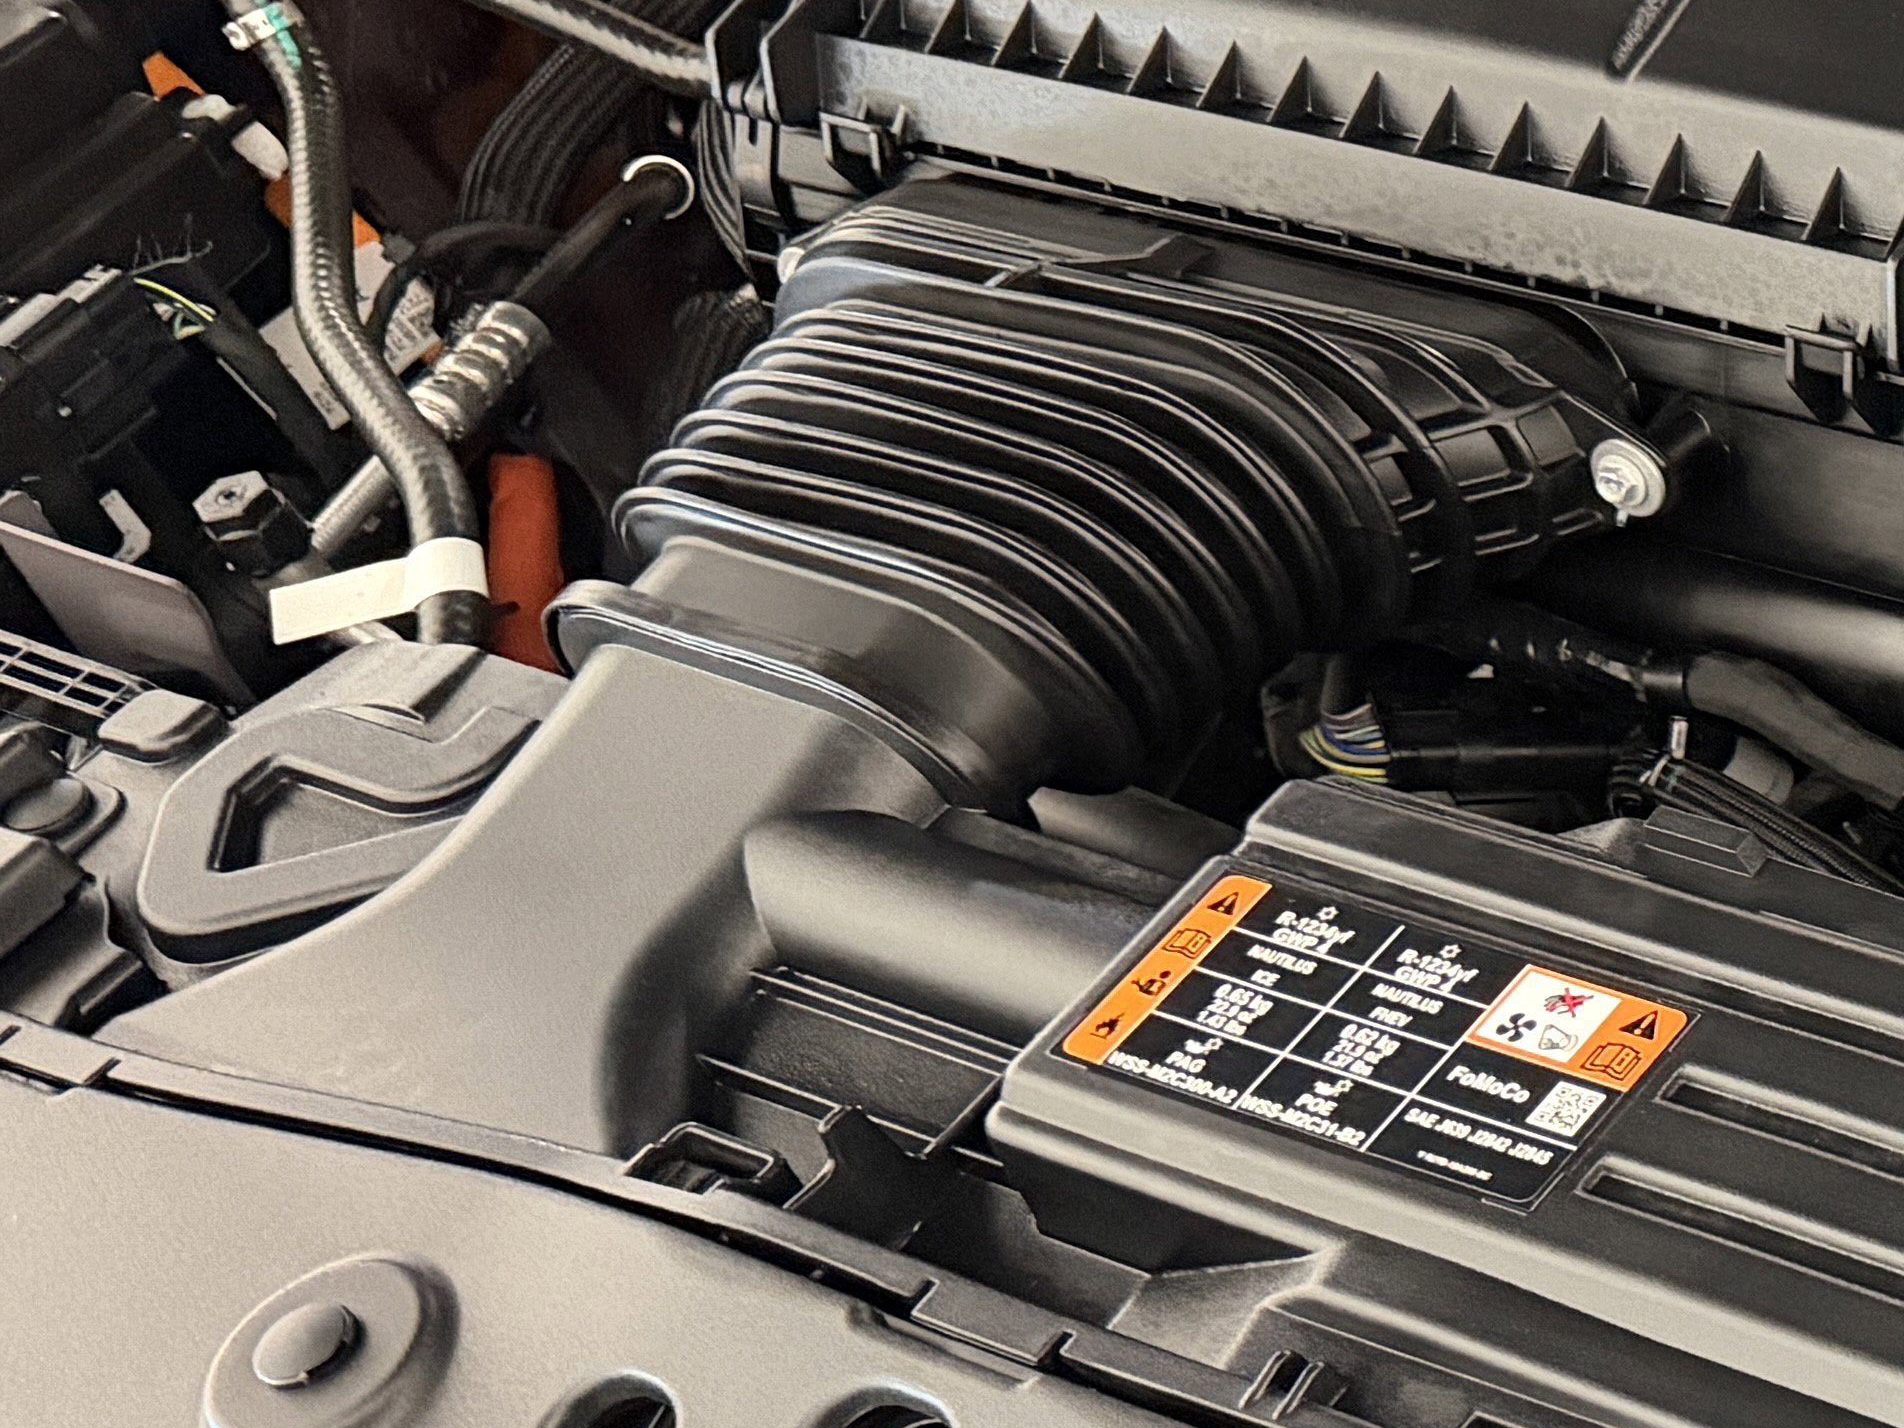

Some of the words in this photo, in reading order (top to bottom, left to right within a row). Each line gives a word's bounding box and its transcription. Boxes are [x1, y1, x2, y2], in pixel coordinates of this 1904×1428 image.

[1267, 926, 1321, 950] GWP
[1269, 909, 1357, 947] R-1234yf
[1243, 943, 1321, 975] NAUTILUS
[1391, 947, 1482, 985] R-1234yf
[1247, 968, 1282, 987] ICE
[1390, 963, 1445, 989] GWP
[1210, 982, 1257, 1006] 0.65
[1243, 993, 1279, 1017] kg
[1367, 982, 1447, 1015] NAUTILUS
[1369, 1034, 1405, 1057] kg
[1161, 1050, 1210, 1074] PAG
[1101, 1050, 1243, 1104] WSS-M2C300-A2
[1442, 1064, 1537, 1105] FoMoCo
[1291, 1092, 1340, 1117] POE
[1401, 1107, 1442, 1129] SAE
